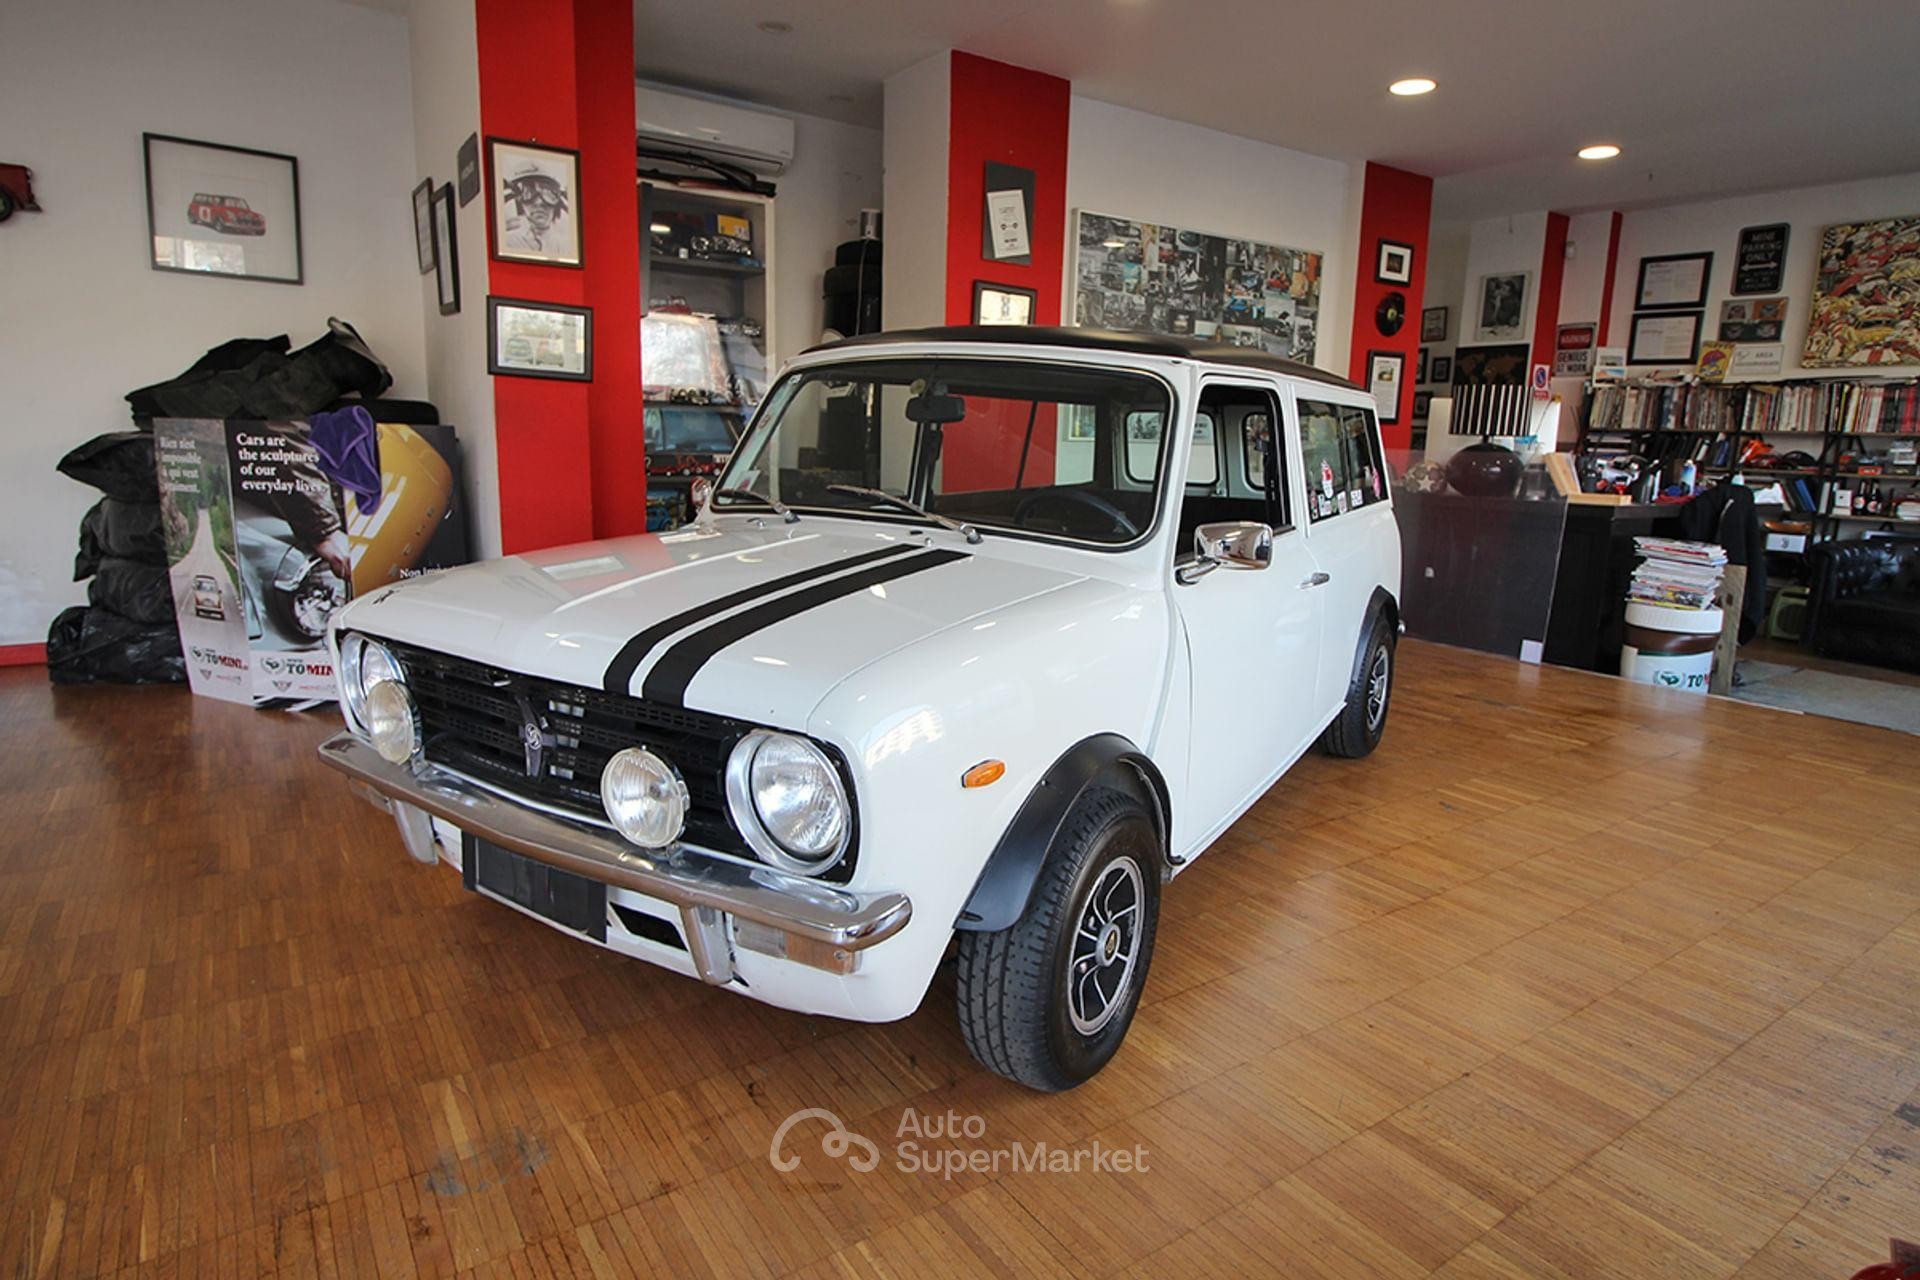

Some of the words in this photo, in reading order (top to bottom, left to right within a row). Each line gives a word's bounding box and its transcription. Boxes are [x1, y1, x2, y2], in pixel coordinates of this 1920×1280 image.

[236, 432, 265, 446] Cars
[267, 437, 286, 447] are
[238, 448, 258, 461] the
[260, 449, 320, 465] sculptures
[240, 462, 254, 475] of
[255, 466, 277, 476] our
[242, 479, 294, 495] everyday
[286, 663, 334, 676] TOMIN
